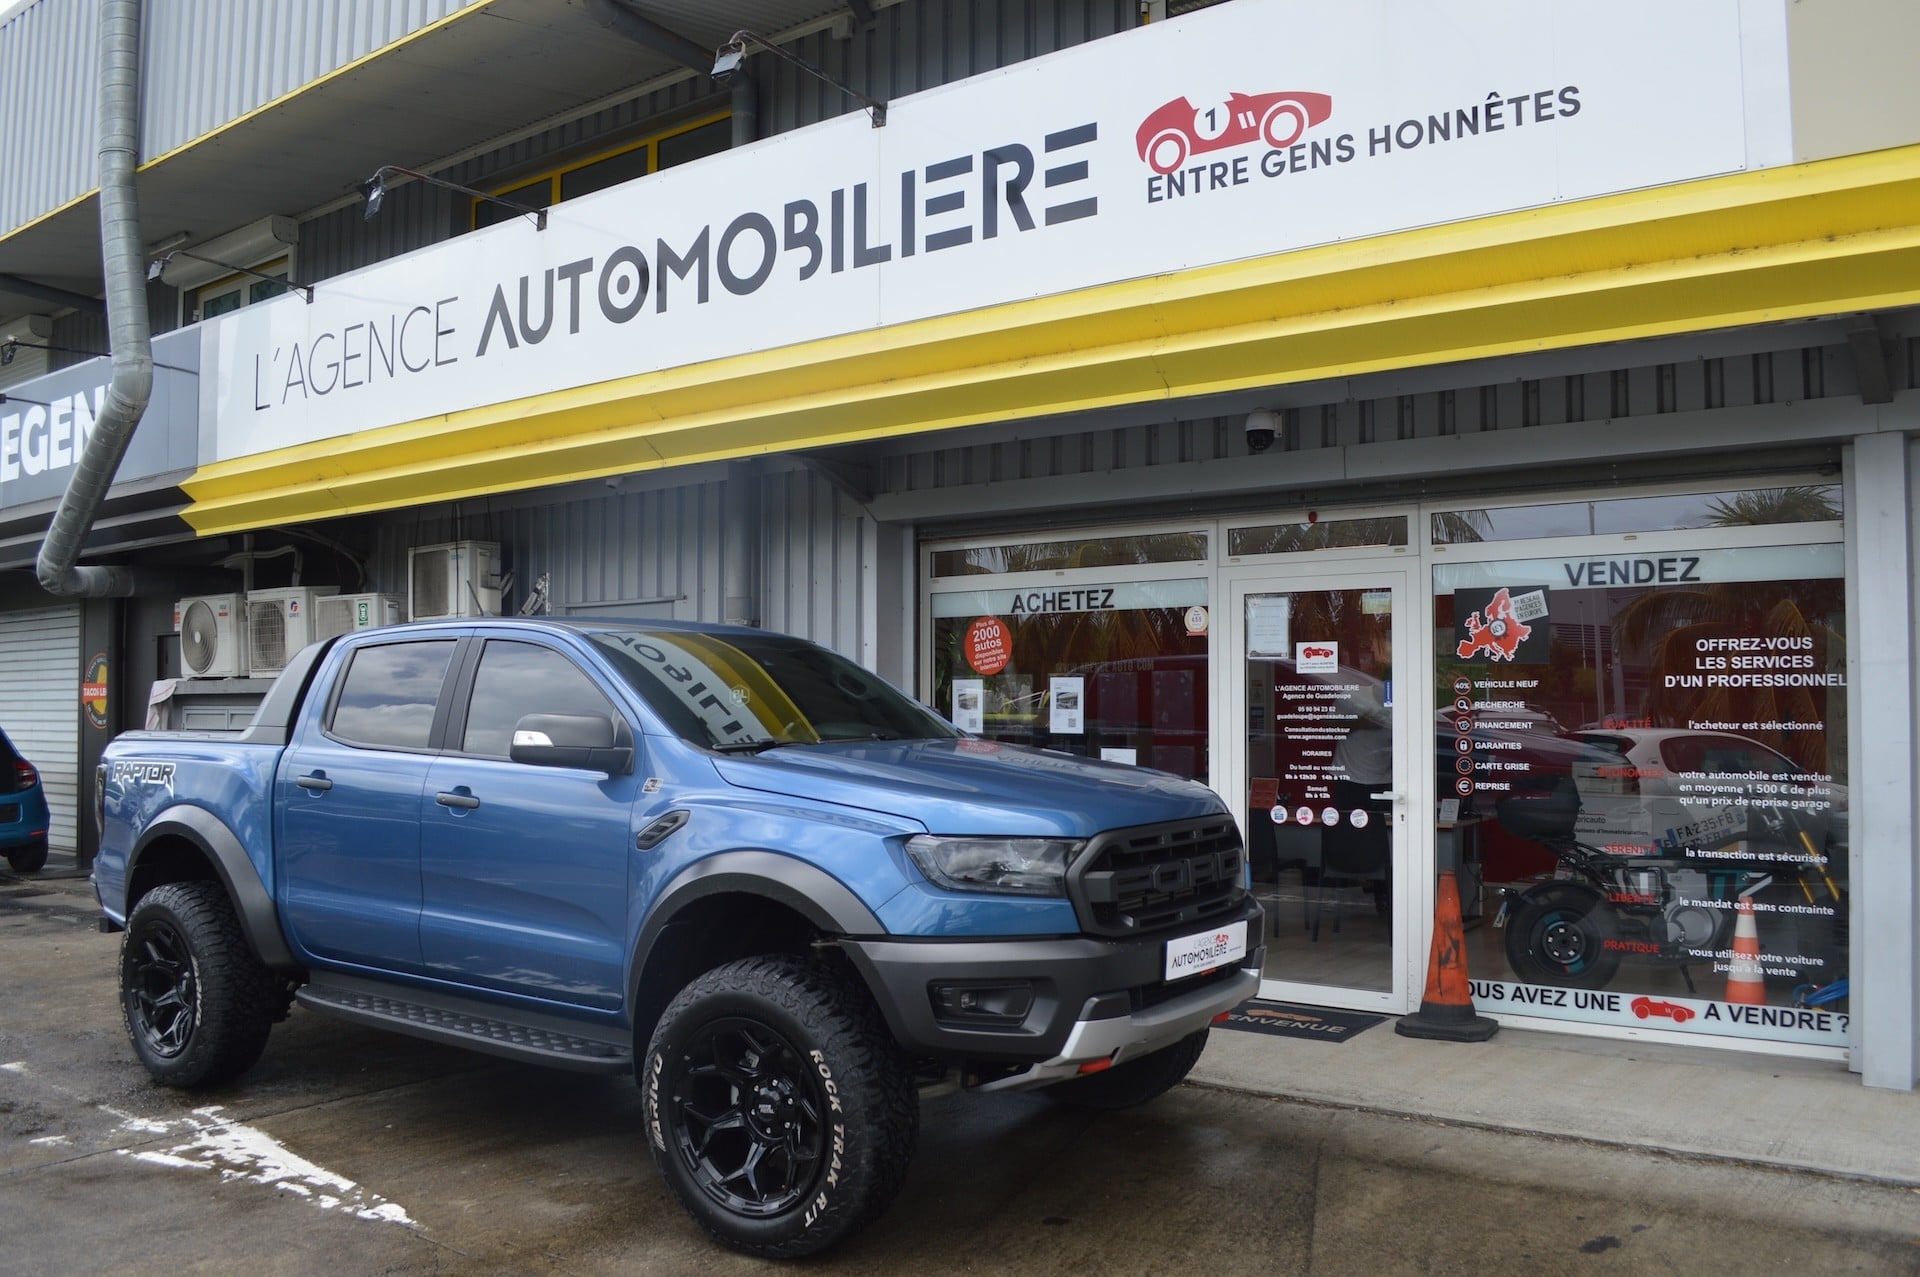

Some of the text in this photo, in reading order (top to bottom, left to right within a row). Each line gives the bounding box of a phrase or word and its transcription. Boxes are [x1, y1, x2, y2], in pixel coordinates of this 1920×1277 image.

[1147, 85, 1582, 204] ENTRE GENS HONNÊTES
[255, 121, 1098, 411] L'AGENCE AUTOMOBILIERE
[1564, 557, 1700, 586] VENDEZ
[1011, 588, 1115, 613] ACHETEZ
[973, 625, 1000, 642] 2000
[975, 638, 1002, 652] autos
[1696, 637, 1813, 651] OFFREZ-VOUS
[1696, 655, 1814, 670] LES SERVICES
[1517, 680, 1538, 688] NEUF
[1664, 673, 1848, 688] D'UN PROFESSIONNEL
[83, 687, 98, 697] TACOS
[1474, 701, 1525, 709] RECHERCHE
[1689, 719, 1740, 731] l'acheteur
[1742, 721, 1758, 731] est
[1760, 719, 1823, 731] sélectionné
[1474, 742, 1522, 750] GARANTIES
[1475, 762, 1530, 770] CARTE GRISE
[112, 761, 176, 800] RAPTOR
[1679, 771, 1706, 780] votre
[1708, 770, 1769, 781] automobile
[1772, 772, 1788, 782] est
[1790, 771, 1832, 783] vendue
[1475, 782, 1511, 791] REPRISE
[1695, 785, 1743, 795] moyenne
[1755, 784, 1778, 794] 500
[1780, 784, 1788, 794] €
[1789, 784, 1804, 795] de
[1807, 785, 1831, 797] plus
[1679, 796, 1831, 811] qu'un prix de reprise garage
[1685, 848, 1695, 857] la
[1697, 849, 1755, 860] transaction
[1758, 852, 1774, 861] est
[1776, 851, 1828, 864] sécurisée
[1680, 897, 1689, 906] le
[1692, 898, 1732, 910] mandat
[1734, 901, 1750, 911] est
[1752, 902, 1776, 912] sans
[1778, 903, 1834, 916] contrainte
[1604, 939, 1824, 966] PRATIQUE vous utilisez votre voiture
[1753, 963, 1763, 974] la
[1766, 967, 1797, 977] vente
[1511, 986, 1567, 1007] AVEZ
[1574, 991, 1621, 1012] UNE
[1703, 1003, 1721, 1021] A
[1728, 1004, 1832, 1032] VENDRE
[804, 1050, 845, 1228] ROCK TRAK R/T
